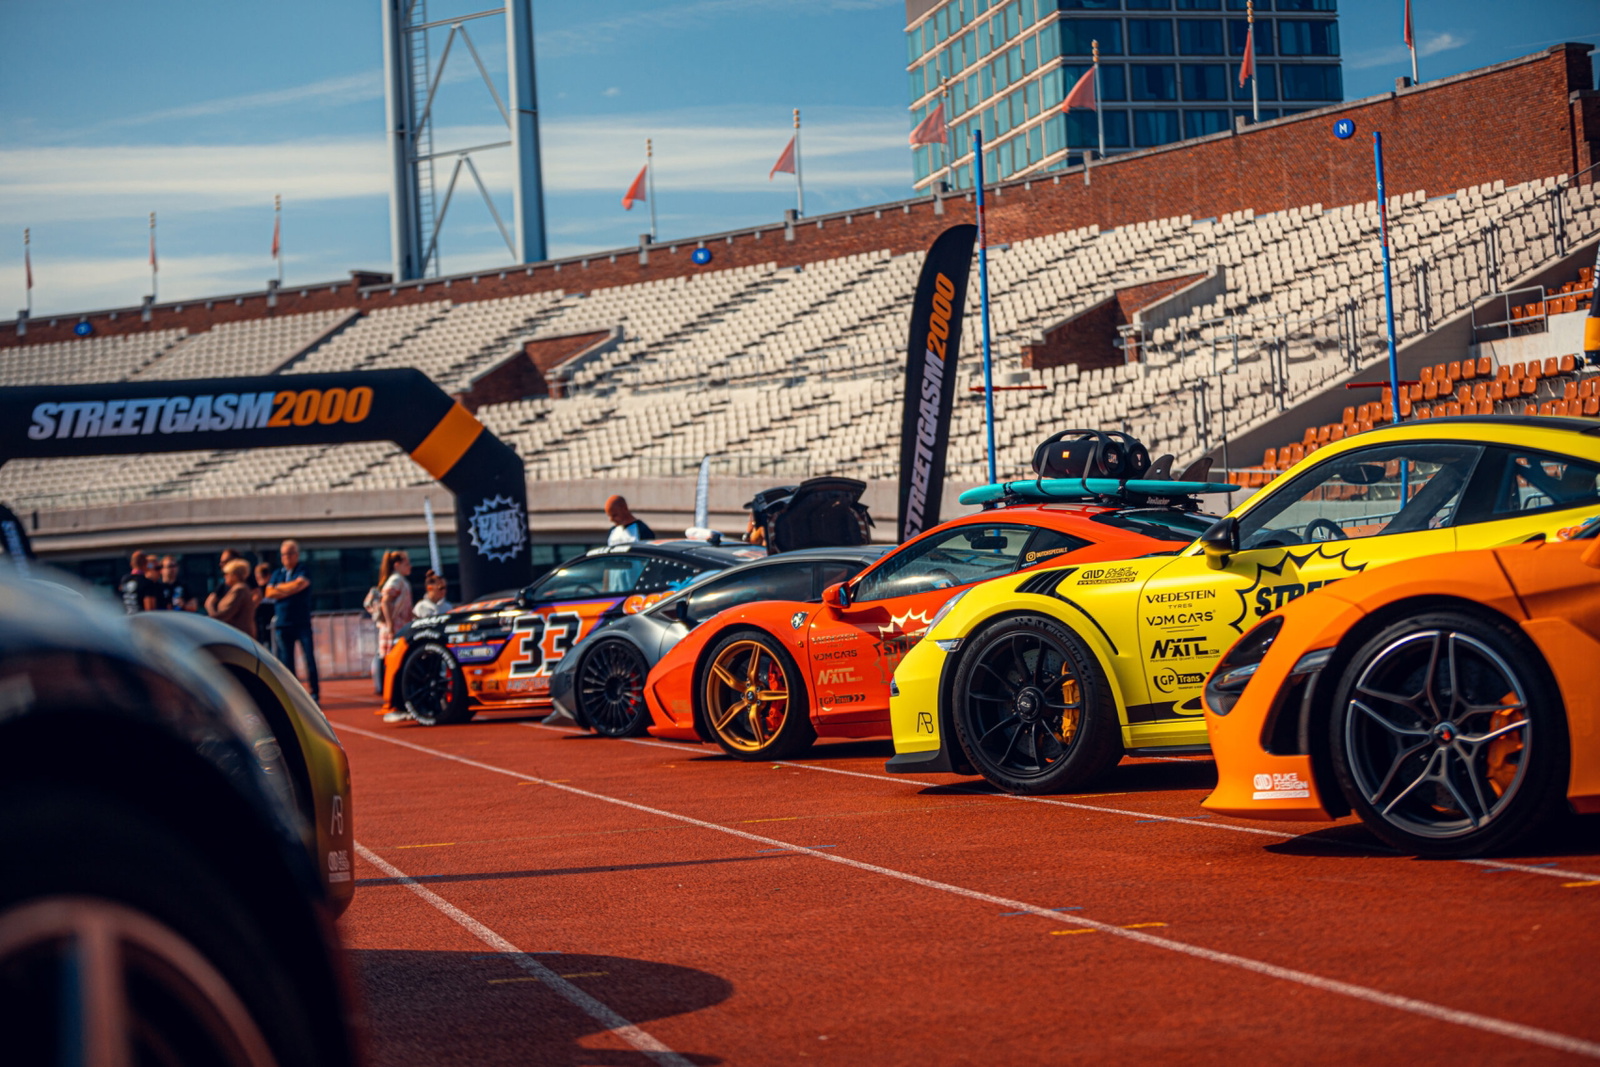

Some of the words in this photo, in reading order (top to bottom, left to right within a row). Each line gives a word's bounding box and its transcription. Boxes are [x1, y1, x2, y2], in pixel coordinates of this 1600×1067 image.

[1338, 122, 1348, 135] N
[28, 386, 373, 440] STREETGASM2000
[1146, 589, 1216, 603] VREDESTEIN
[1045, 624, 1083, 663] MICHELIN
[1160, 675, 1175, 685] GP
[1178, 675, 1201, 683] Trans
